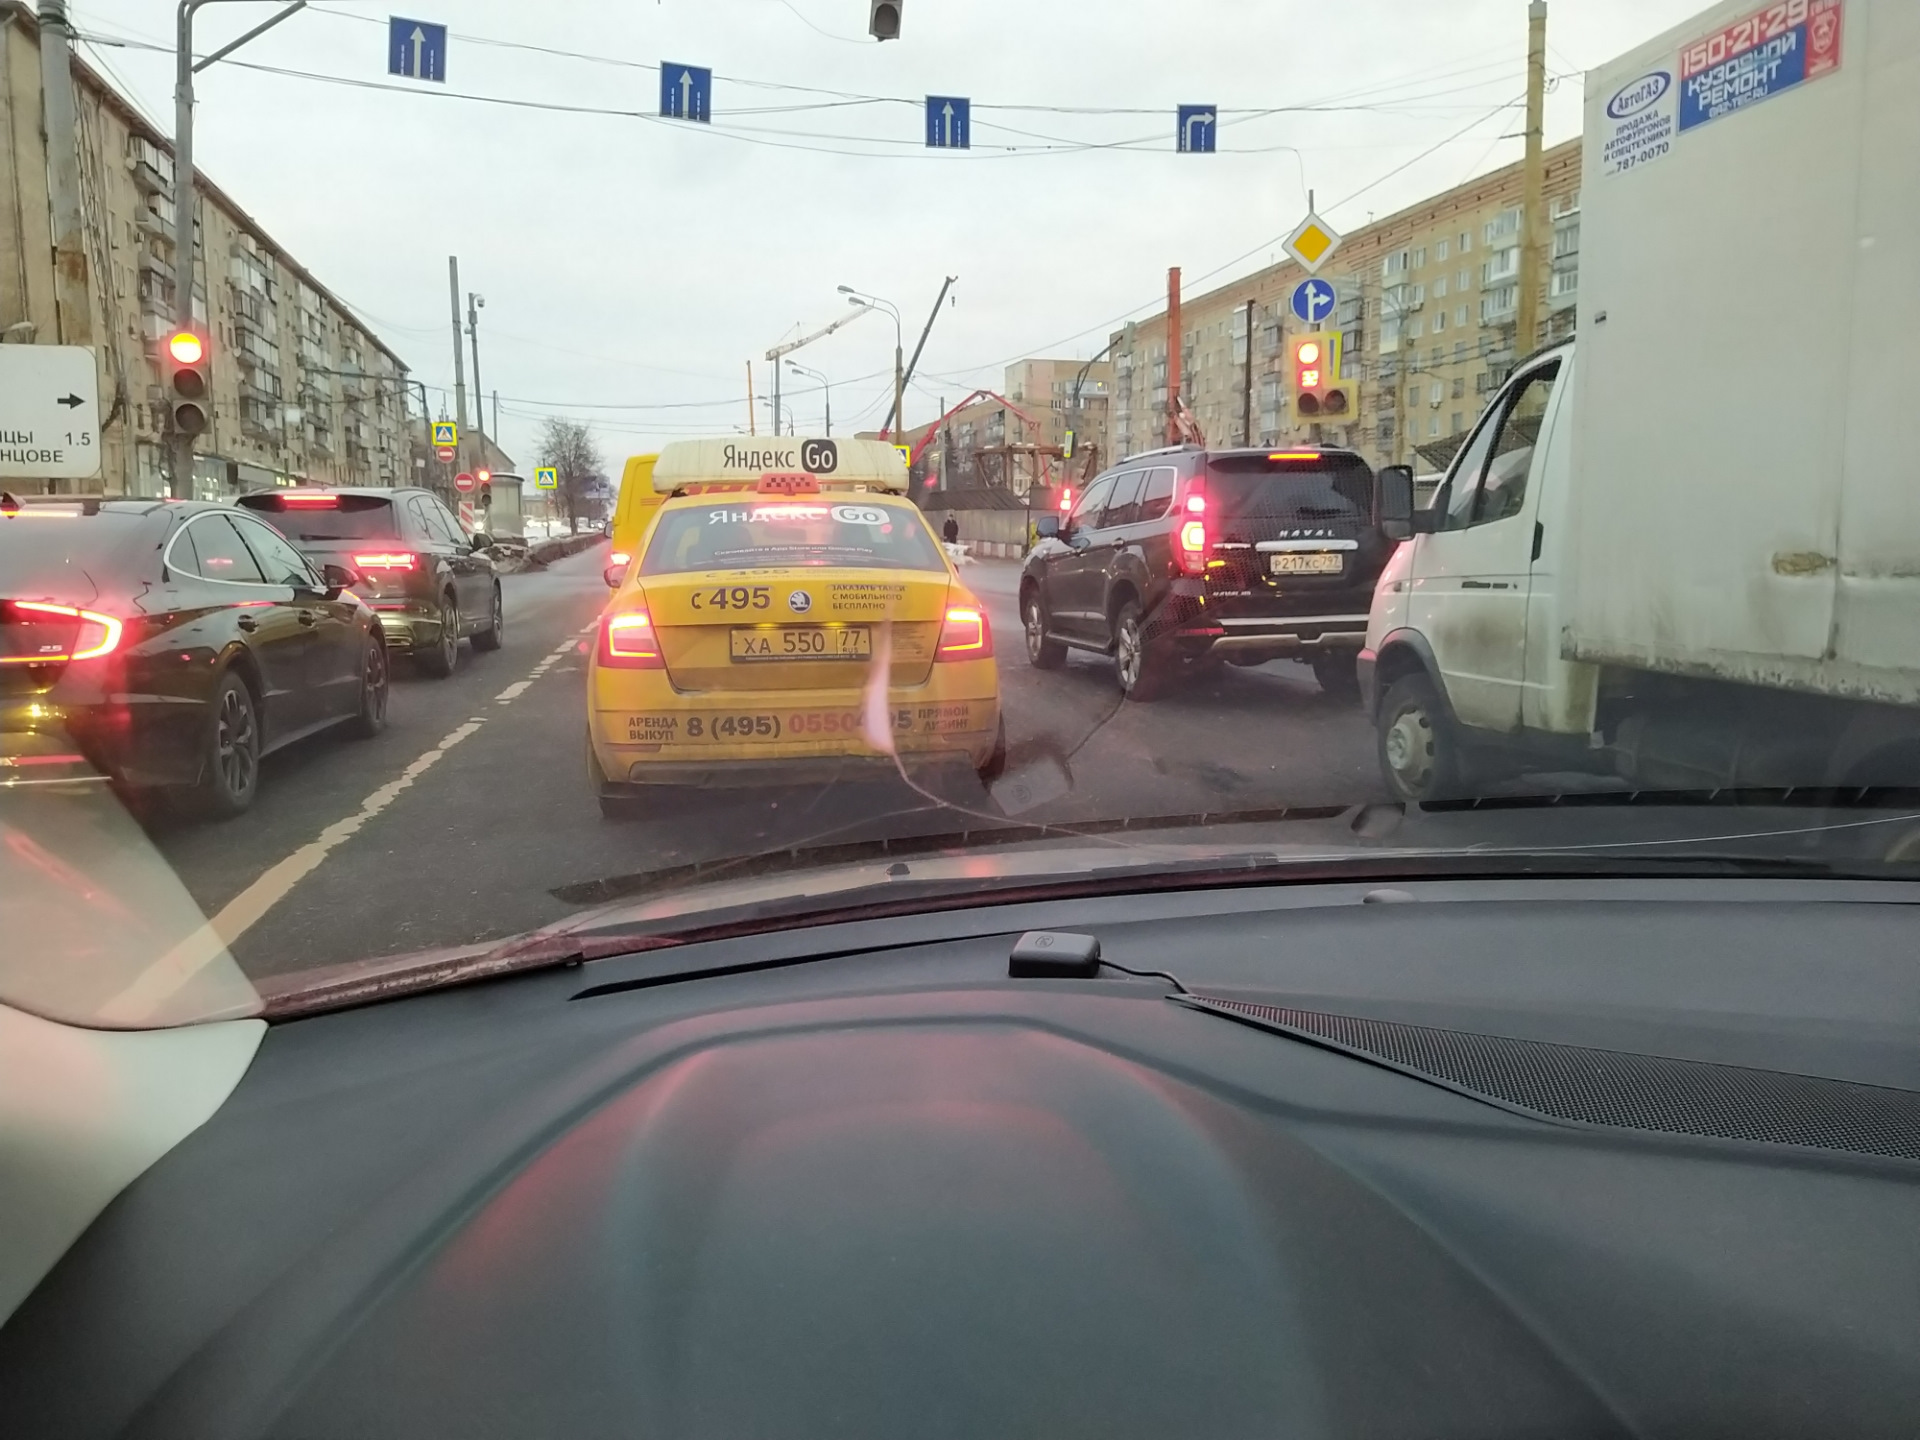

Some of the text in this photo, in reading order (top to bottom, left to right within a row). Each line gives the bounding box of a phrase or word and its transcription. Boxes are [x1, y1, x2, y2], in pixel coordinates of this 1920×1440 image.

[1688, 31, 1796, 97] КУЗОВНОЙ
[1699, 59, 1781, 111] РЕМОНТ
[1604, 115, 1671, 152] АВТОФУРГОНОВ
[1616, 110, 1659, 136] ПРОДАЖА
[1611, 127, 1671, 160] СПЕЦТЕХНИКИ
[1616, 141, 1670, 173] 787-0070
[65, 432, 91, 446] 1.5
[723, 443, 835, 471] Яндекс Go
[838, 506, 880, 523] Go
[1280, 529, 1335, 537] HAVAL
[709, 587, 771, 610] 495
[833, 602, 886, 610] БЕСПЛАТНО
[840, 593, 903, 601] МОБИЛЬНОГО
[744, 631, 861, 654] ХА 550 77
[629, 717, 679, 728] АРЕНДА
[919, 705, 969, 719] ПРЯМОЙ
[630, 730, 674, 741] ВЫКУП
[687, 717, 704, 737] 8
[711, 715, 781, 740] (495)
[924, 719, 969, 731] ЛИЗИНГ
